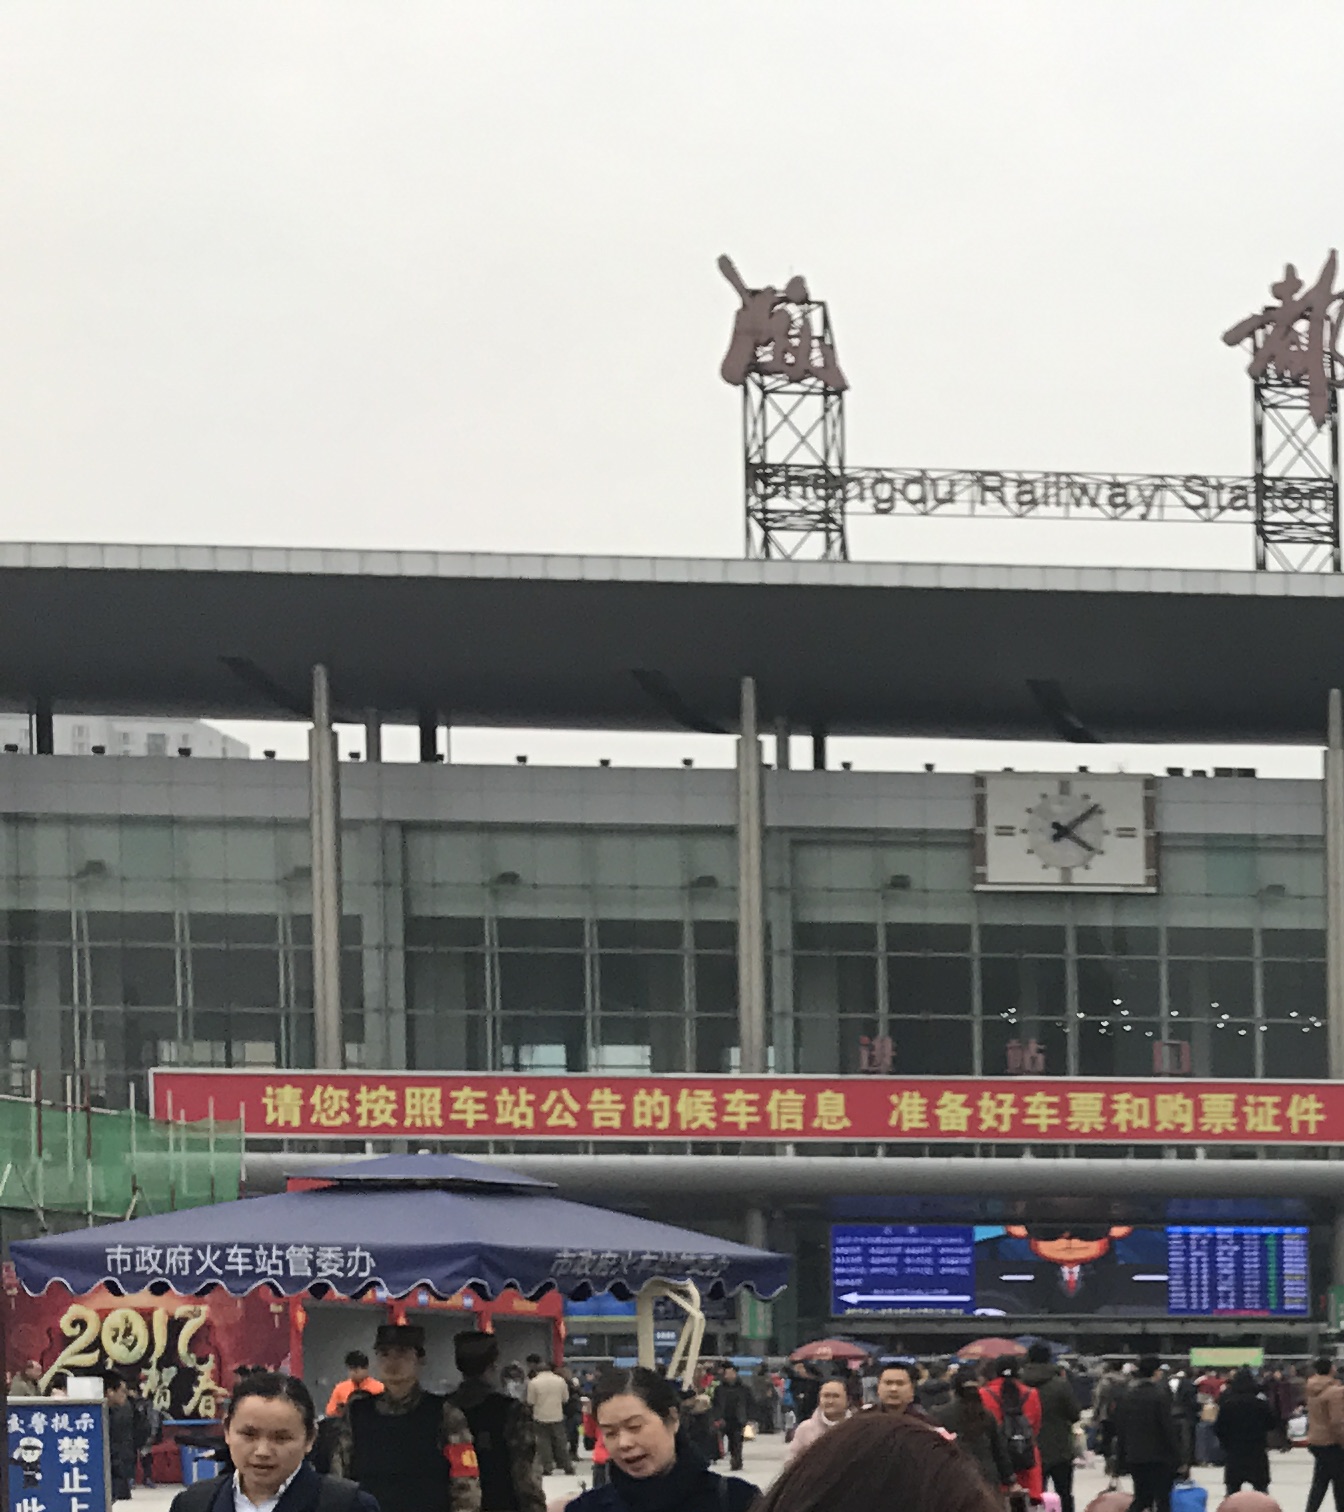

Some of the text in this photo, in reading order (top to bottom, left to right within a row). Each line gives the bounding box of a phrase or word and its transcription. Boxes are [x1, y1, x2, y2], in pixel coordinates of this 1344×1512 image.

[978, 470, 1159, 521] Railway
[262, 1085, 852, 1132] 请您按照车站公告的候车信息
[889, 1090, 1326, 1135] 准备好车票和购票证件
[105, 1244, 377, 1277] 市政府火车站管委办
